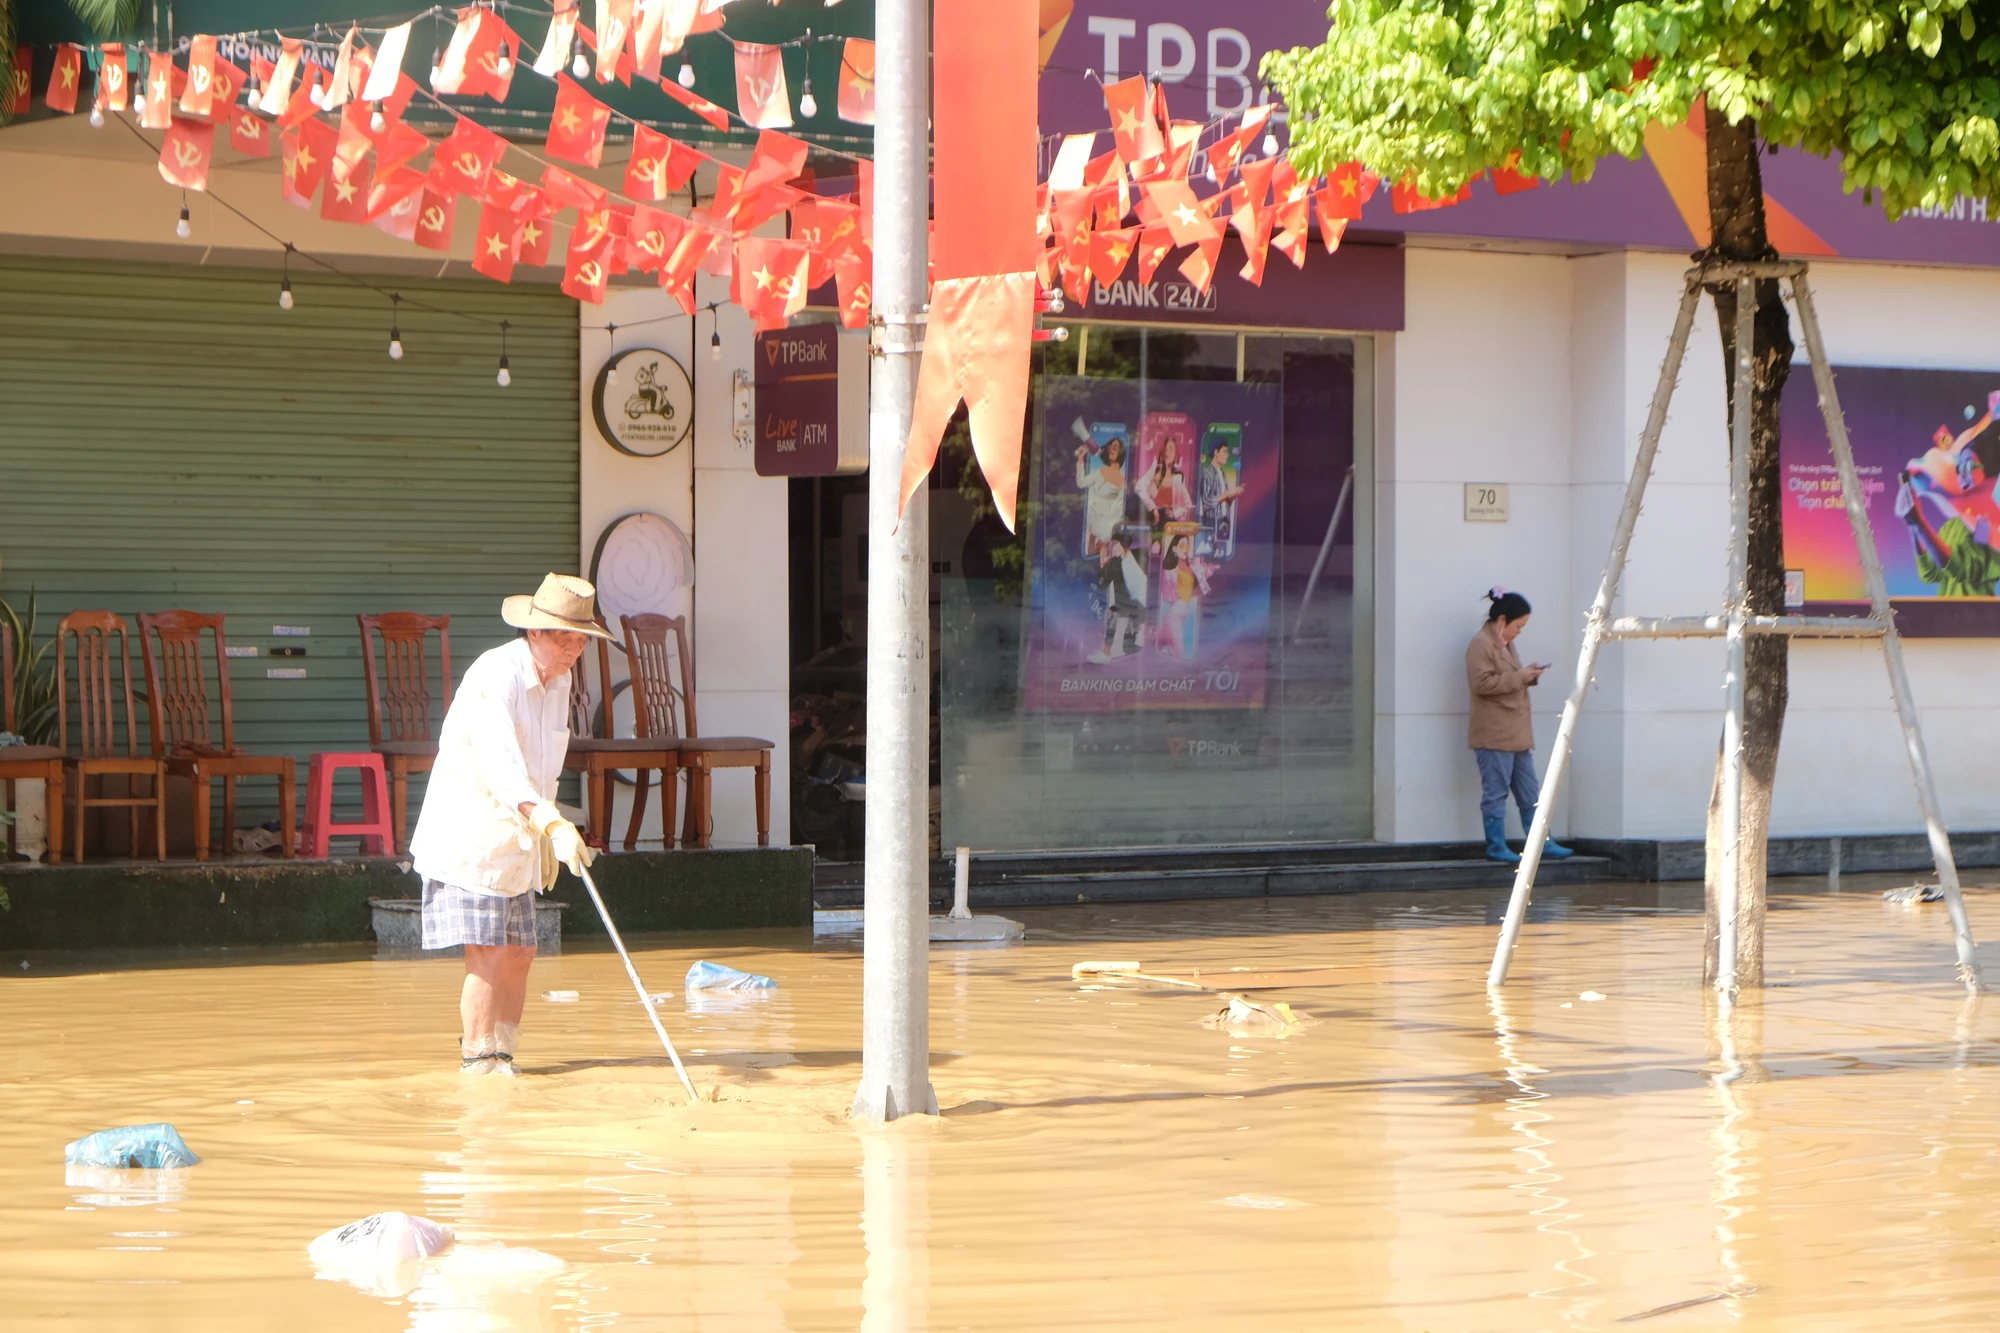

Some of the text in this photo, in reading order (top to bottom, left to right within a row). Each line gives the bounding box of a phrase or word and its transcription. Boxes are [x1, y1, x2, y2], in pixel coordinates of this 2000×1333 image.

[1094, 280, 1160, 308] BANK
[782, 339, 828, 365] TPBank
[765, 413, 798, 439] Live
[803, 423, 827, 445] ATM
[776, 439, 797, 453] BANK
[1479, 489, 1496, 505] 70
[1060, 679, 1123, 692] BANKING
[1203, 664, 1240, 691] TÔI
[1187, 740, 1243, 757] TPBank
